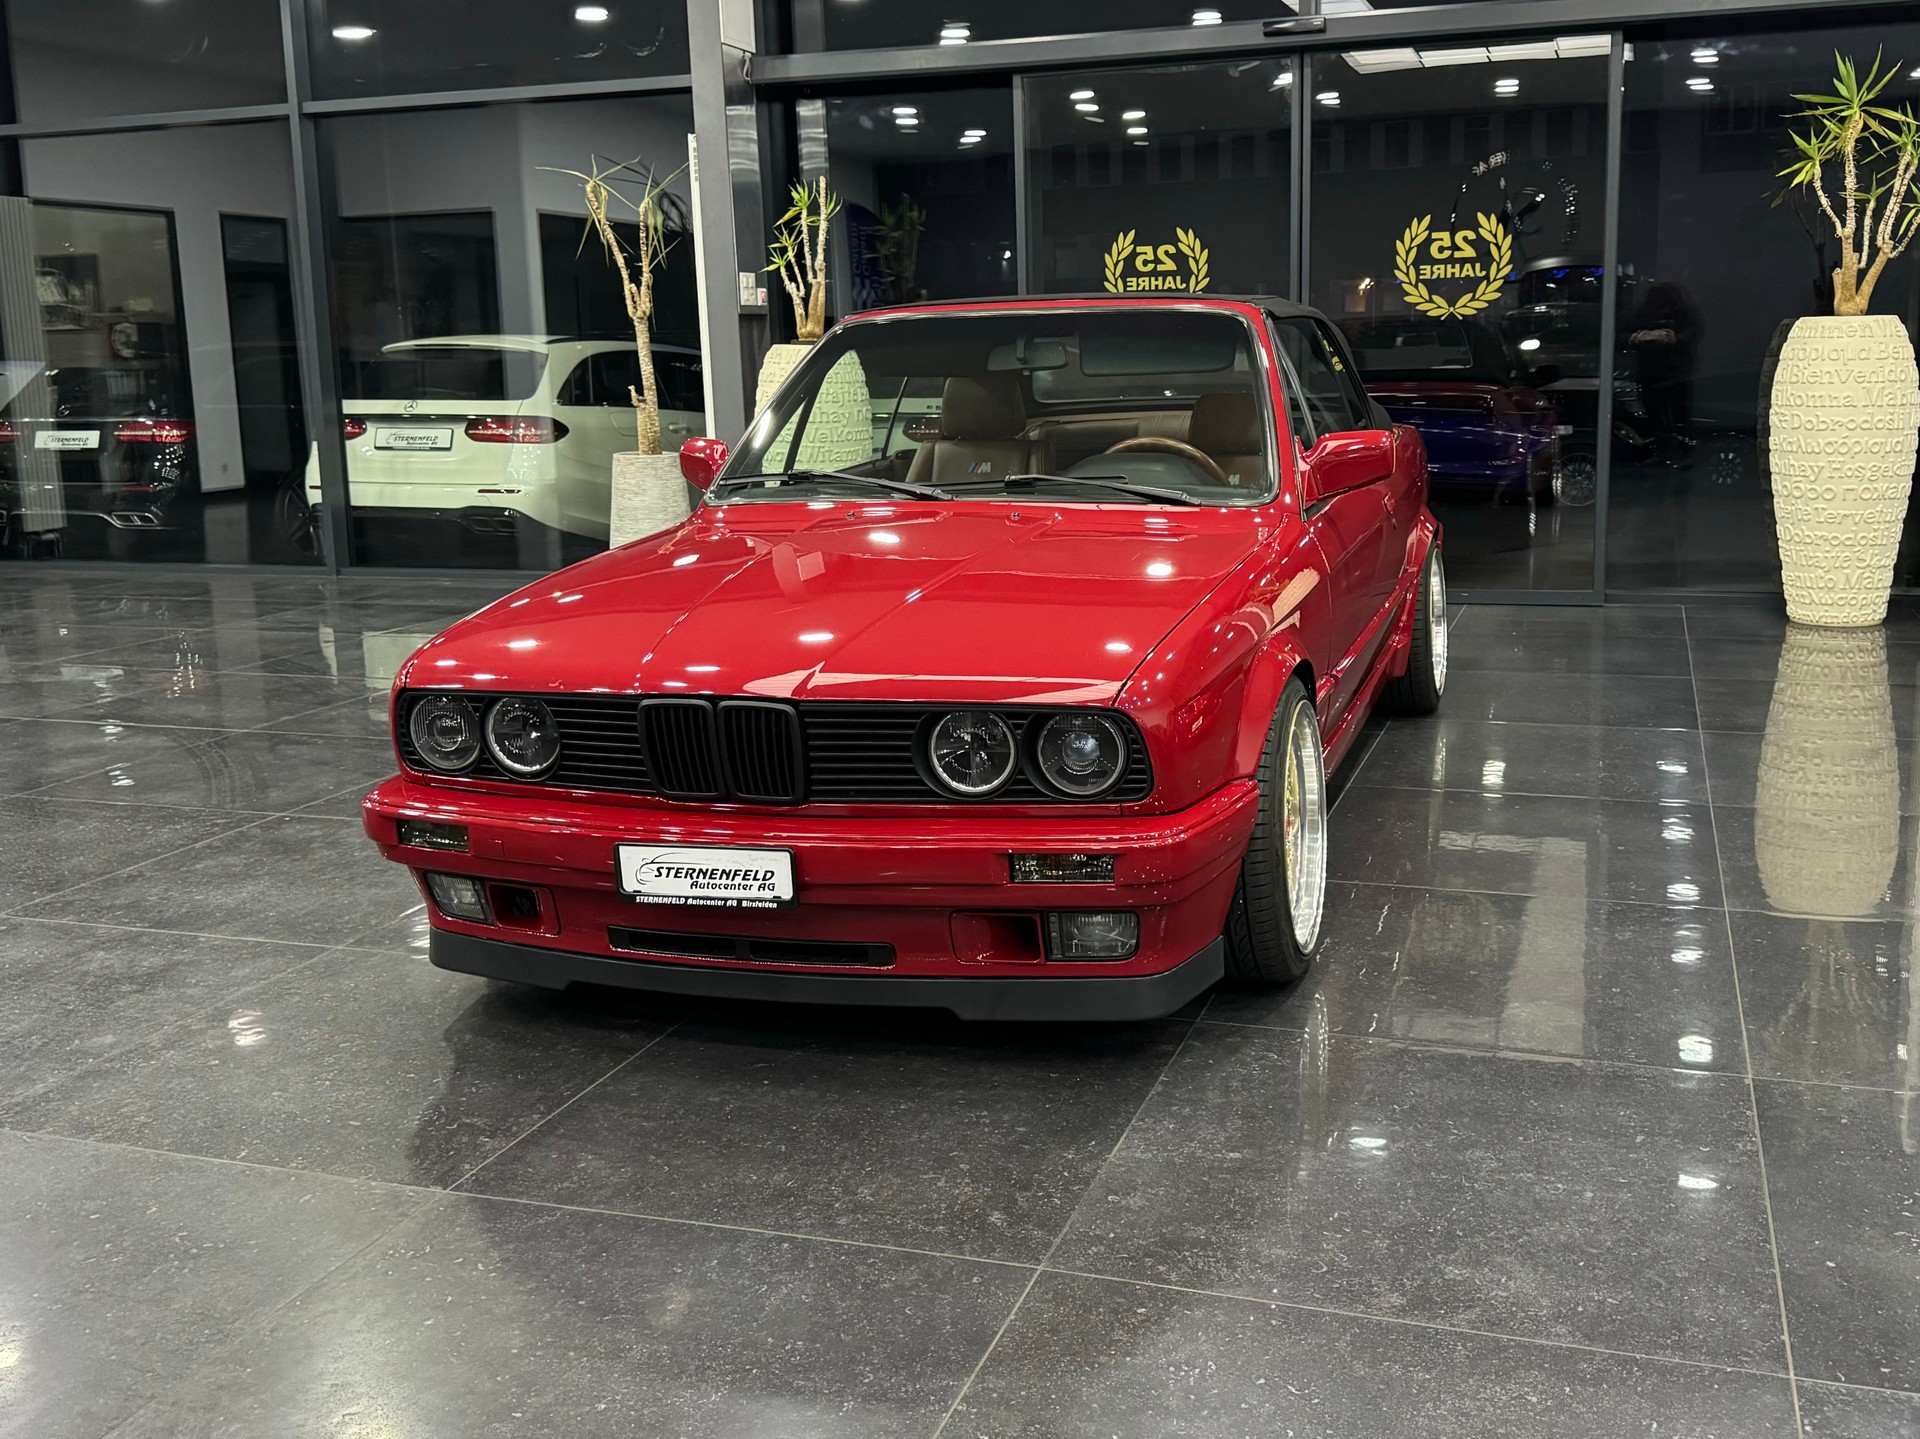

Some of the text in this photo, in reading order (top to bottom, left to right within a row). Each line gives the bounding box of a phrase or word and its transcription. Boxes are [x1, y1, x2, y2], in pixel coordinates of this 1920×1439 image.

[1788, 363, 1905, 384] Bienvenido
[1790, 408, 1905, 431] Dobrodošli
[654, 867, 775, 882] STERNENFELD
[690, 880, 776, 892] Autocenter AG
[636, 896, 685, 905] STERNENFELD
[687, 897, 725, 906] Autocenter
[726, 899, 738, 907] AG
